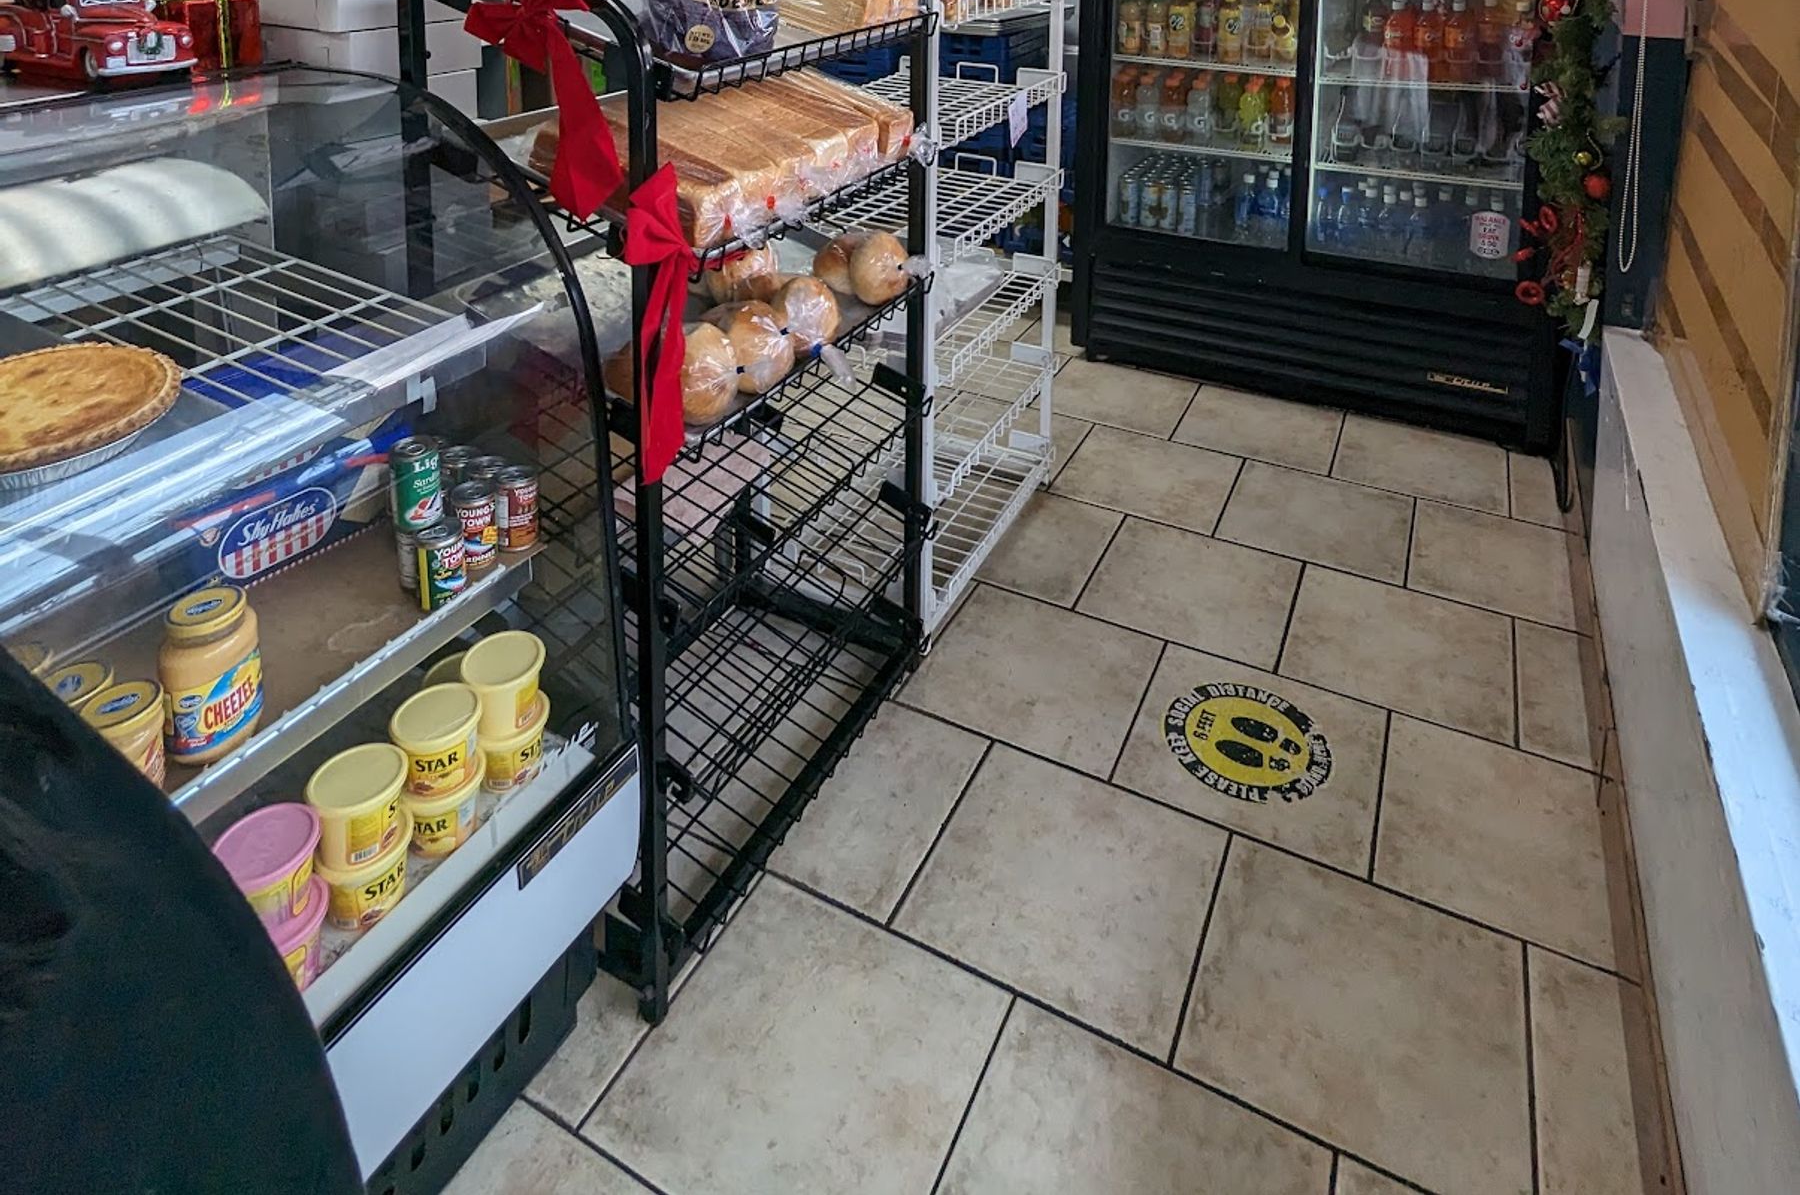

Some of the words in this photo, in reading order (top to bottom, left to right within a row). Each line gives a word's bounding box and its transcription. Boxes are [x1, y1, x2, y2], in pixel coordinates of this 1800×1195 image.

[413, 453, 439, 473] Lig
[442, 546, 465, 568] TOW
[415, 751, 459, 773] STAR
[364, 861, 406, 901] STAR
